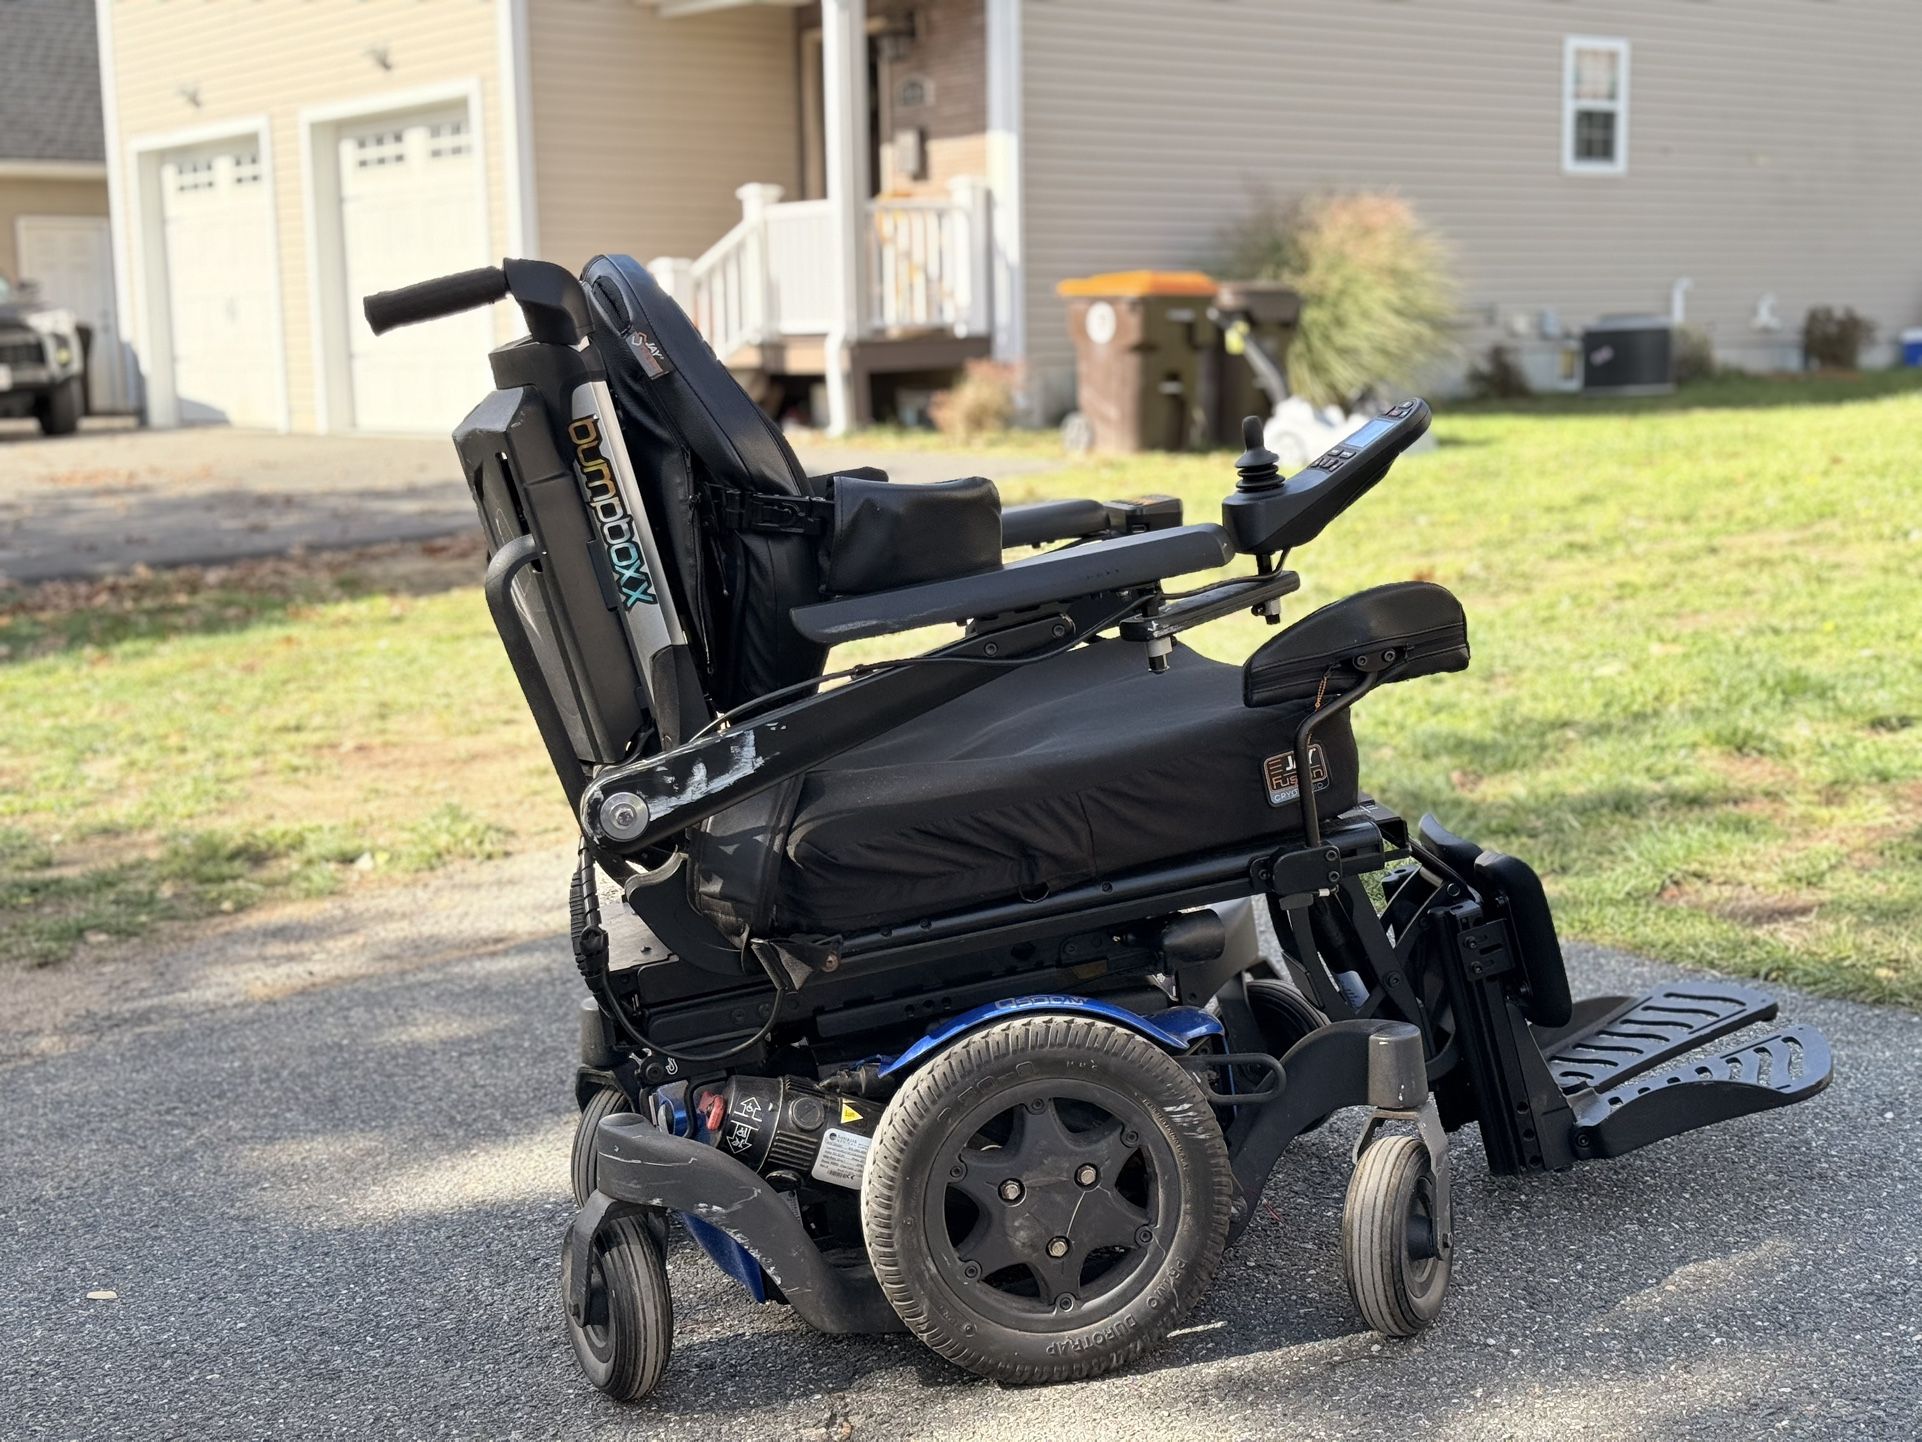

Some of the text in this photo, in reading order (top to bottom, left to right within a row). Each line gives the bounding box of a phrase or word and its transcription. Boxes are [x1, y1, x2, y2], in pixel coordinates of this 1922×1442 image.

[645, 342, 663, 357] JAY
[568, 413, 656, 609] bumpboxx
[1046, 1313, 1137, 1356] DUROTRAP
